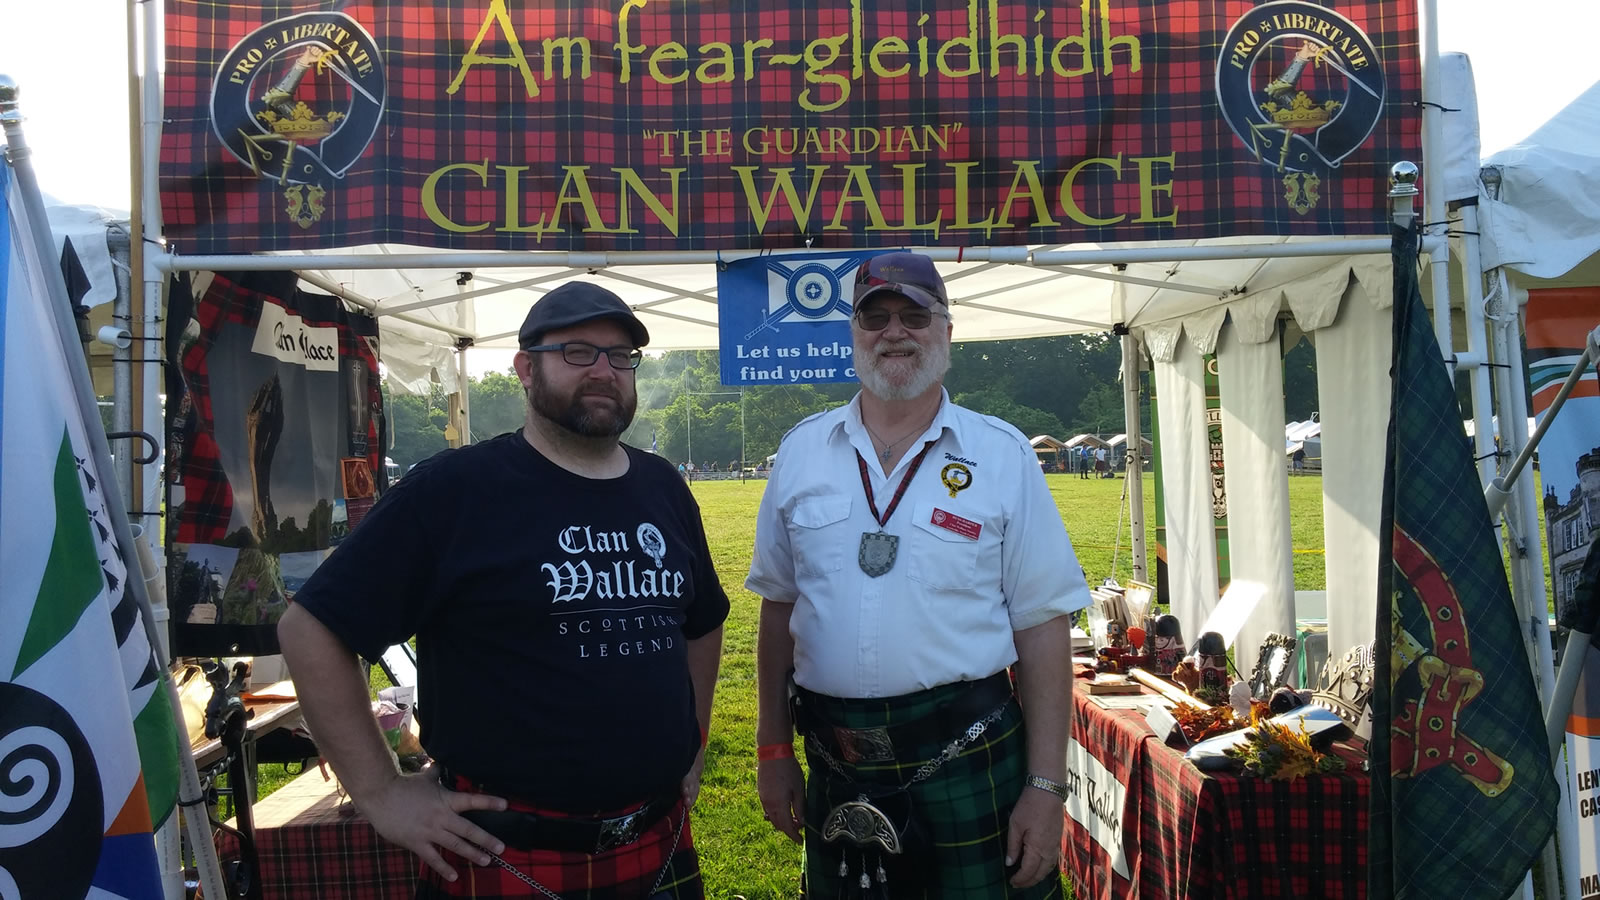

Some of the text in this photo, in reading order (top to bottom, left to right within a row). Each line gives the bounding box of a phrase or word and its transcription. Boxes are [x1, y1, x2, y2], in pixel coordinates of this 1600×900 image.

[229, 22, 374, 86] PRO LIBERTATE
[446, 0, 592, 98] Am
[1230, 13, 1369, 71] PRO LIBERTATE
[421, 151, 1178, 243] CLAN WALLACE
[736, 341, 853, 362] Let us help
[740, 366, 784, 381] find
[790, 367, 837, 382] your
[557, 524, 630, 555] Clan
[540, 559, 685, 604] Wallace
[558, 614, 678, 635] SCOTTISH
[579, 636, 673, 658] LEGEND
